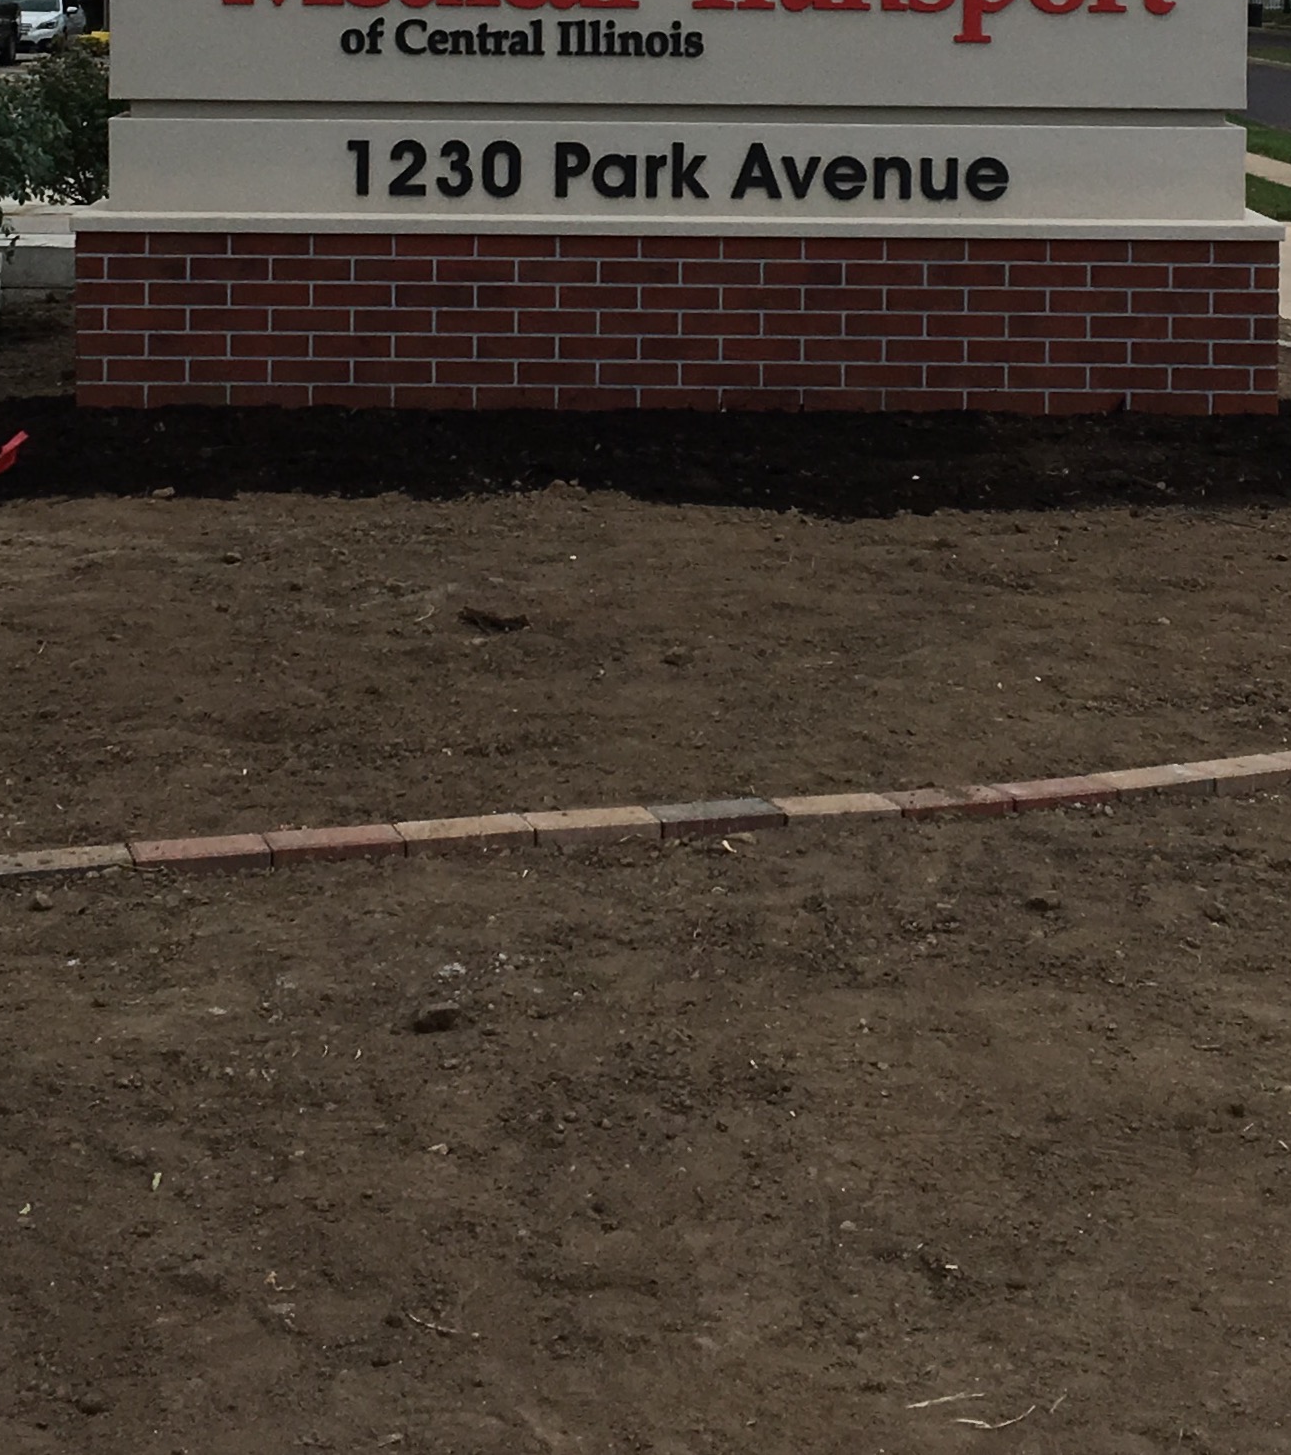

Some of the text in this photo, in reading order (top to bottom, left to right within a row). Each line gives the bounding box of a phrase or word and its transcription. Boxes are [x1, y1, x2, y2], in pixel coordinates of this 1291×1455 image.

[339, 17, 705, 59] of Central Illinois
[346, 139, 1010, 203] 1230 Park Avenue
